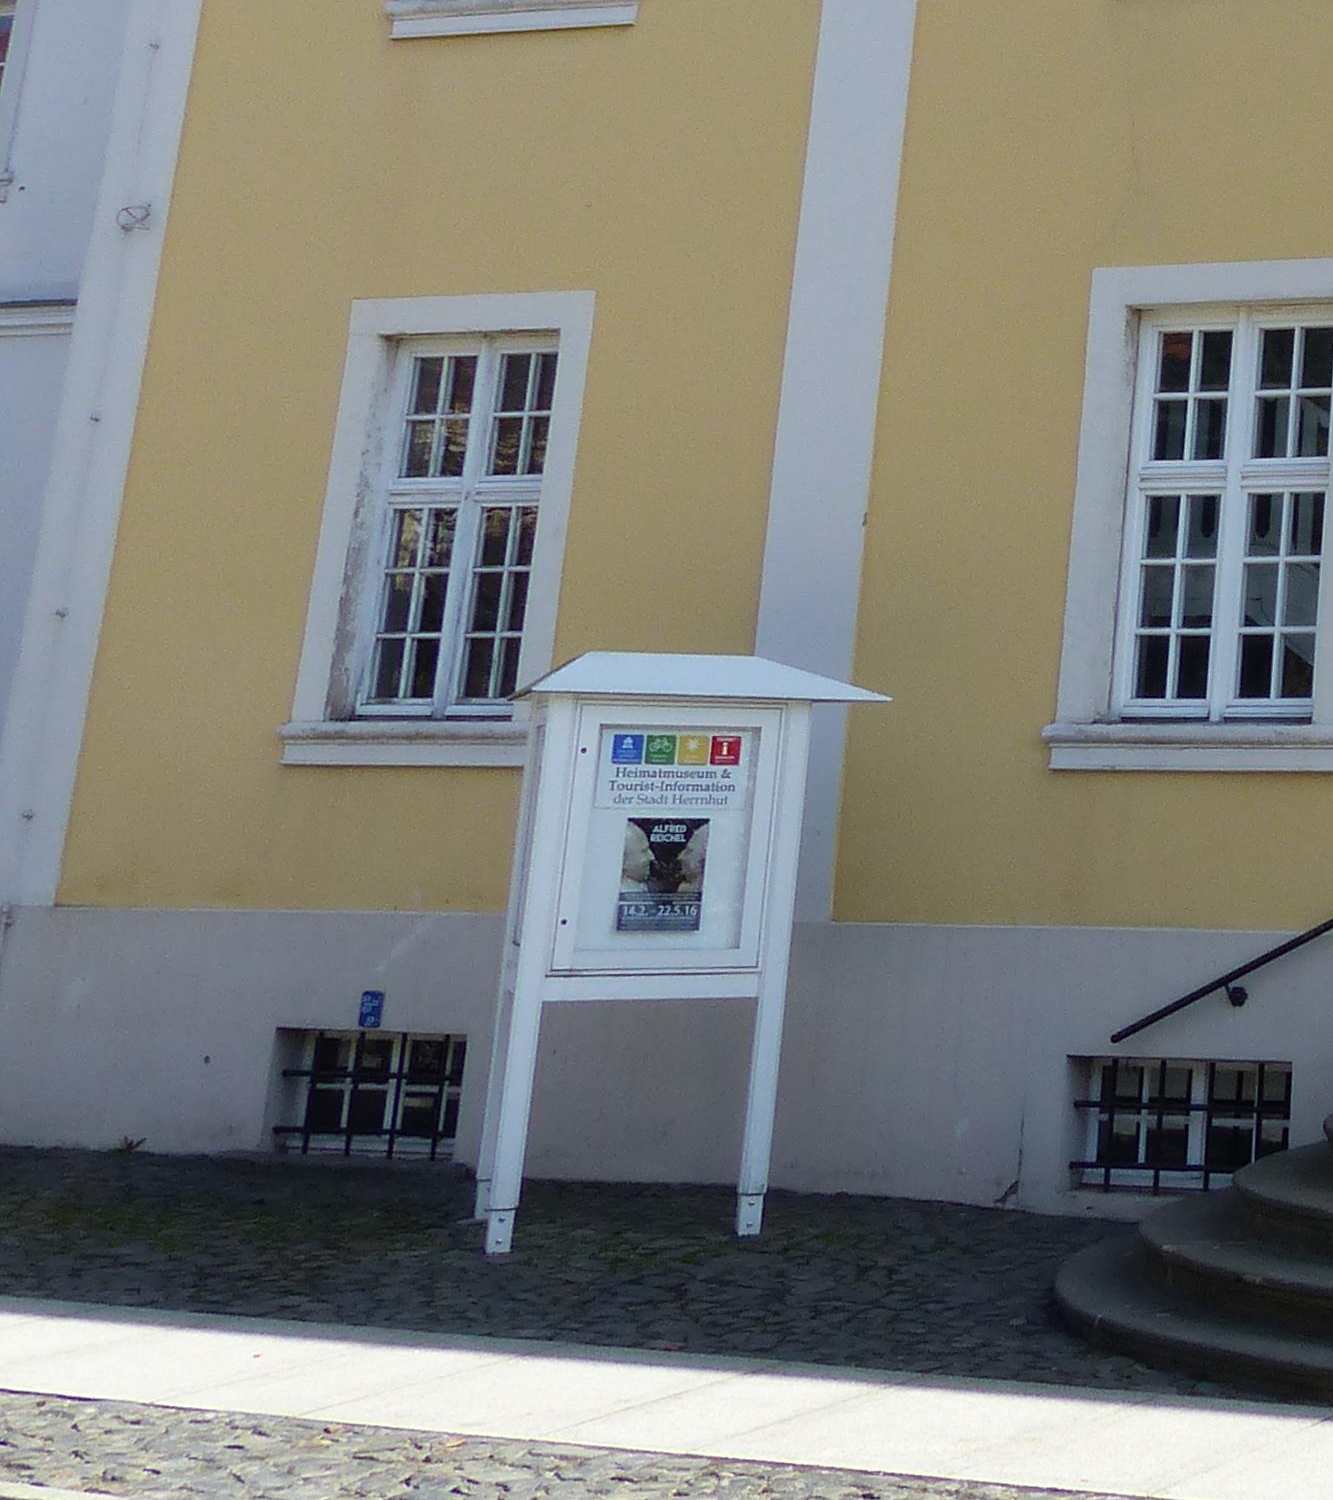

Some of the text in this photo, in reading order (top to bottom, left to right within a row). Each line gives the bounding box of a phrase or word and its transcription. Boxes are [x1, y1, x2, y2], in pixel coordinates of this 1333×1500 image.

[615, 767, 732, 780] Heimatmuseum &
[609, 779, 736, 792] Tourist-Information
[613, 793, 728, 806] der Stadt Herrnhut
[658, 906, 697, 916] 22.5.16
